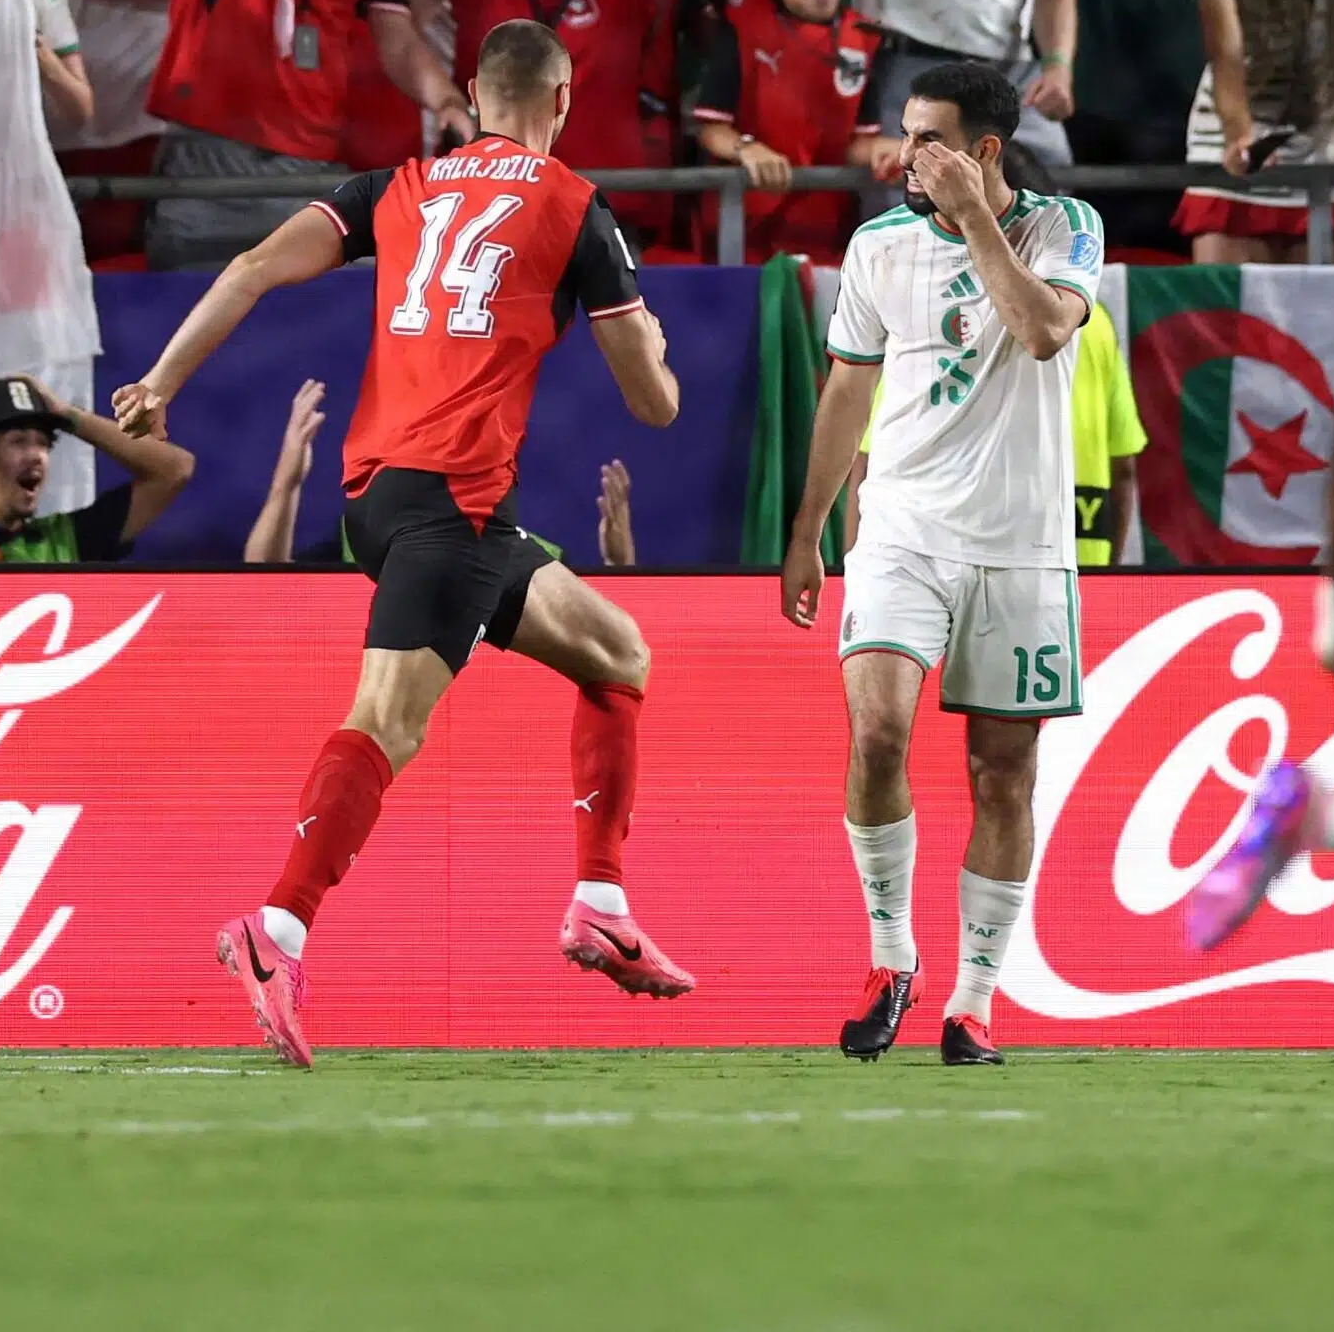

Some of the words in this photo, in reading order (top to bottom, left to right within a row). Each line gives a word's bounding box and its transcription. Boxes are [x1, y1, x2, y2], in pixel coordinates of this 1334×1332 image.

[427, 155, 546, 183] KALAJDZIC
[389, 191, 524, 339] 14
[1013, 644, 1061, 703] 15
[968, 922, 999, 939] FAF
